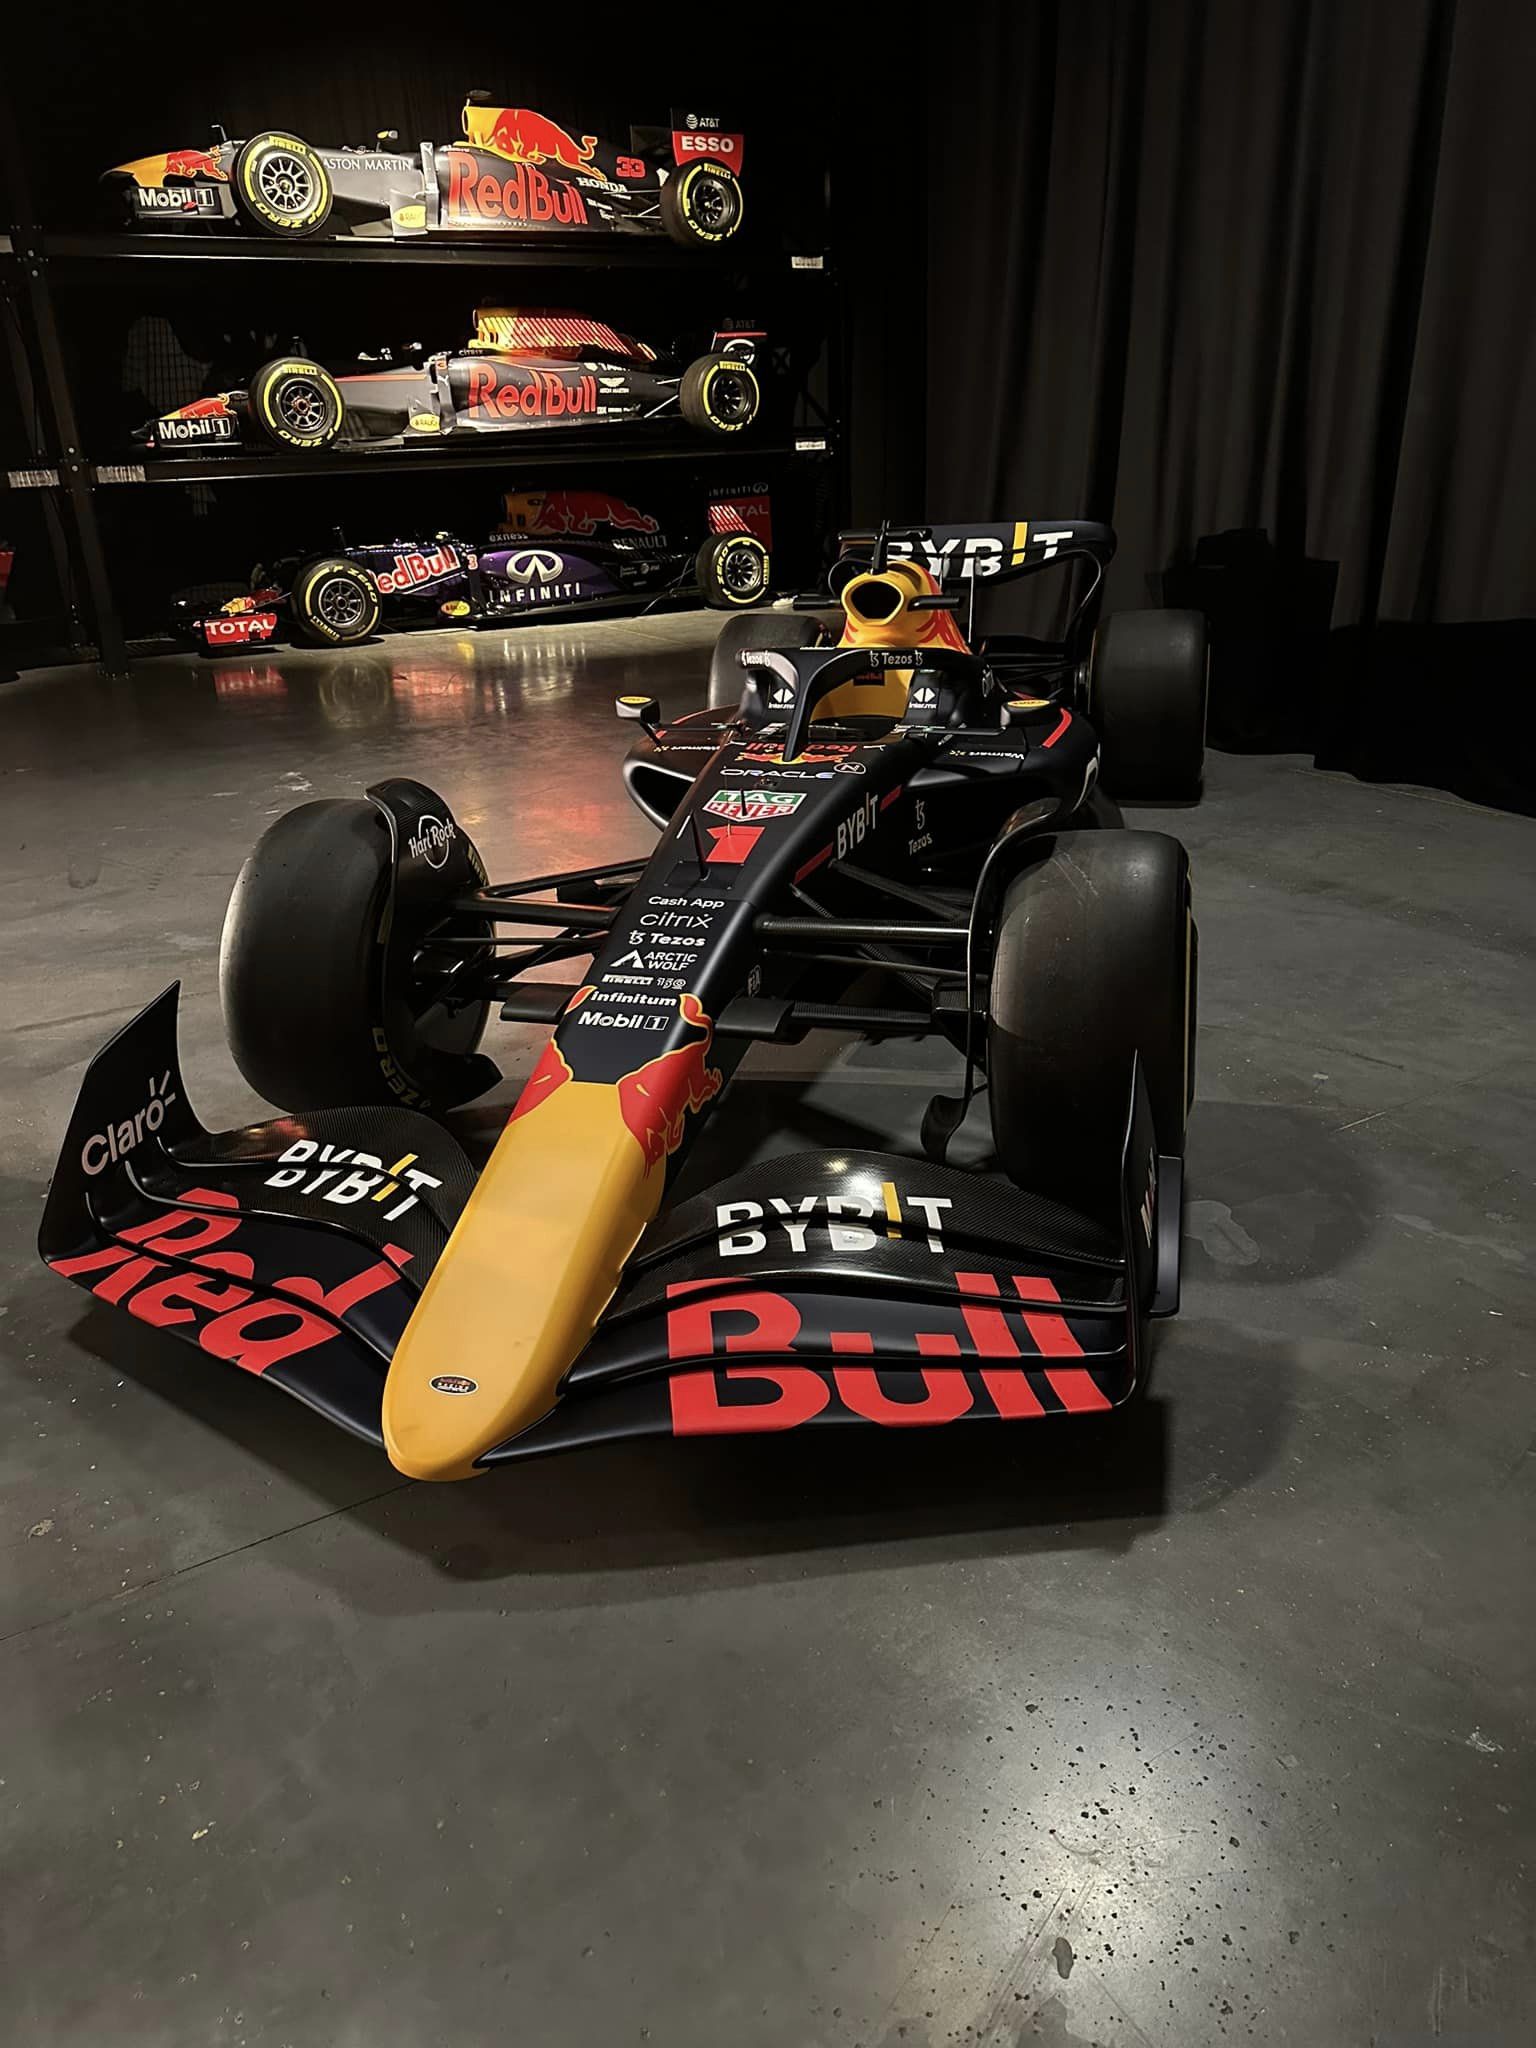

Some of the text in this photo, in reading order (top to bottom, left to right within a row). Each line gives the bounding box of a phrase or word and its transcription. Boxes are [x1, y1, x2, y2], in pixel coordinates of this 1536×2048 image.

[699, 117, 720, 128] AT&T
[681, 135, 735, 153] ESSO
[324, 157, 412, 172] ASTON MARTIN
[616, 156, 646, 178] 33
[576, 176, 629, 193] HONDA
[138, 187, 193, 208] Mobil
[159, 420, 213, 440] Mobil
[488, 582, 582, 603] INFINITI
[206, 617, 276, 637] TOTAL
[881, 651, 913, 665] Tezos
[719, 768, 836, 779] ORACLE
[725, 792, 795, 804] TAG
[709, 804, 794, 818] HEUER
[431, 817, 457, 852] Rock
[837, 792, 879, 861] BYBIT
[706, 825, 766, 864] 1
[908, 831, 934, 857] Tezos
[648, 896, 725, 909] Cash App
[639, 912, 714, 929] citrix
[649, 932, 707, 948] Tezos
[643, 951, 698, 964] ARCTIC
[648, 961, 691, 972] WOLF
[591, 990, 678, 1007] infinitum
[577, 1011, 644, 1029] Mobil
[715, 1181, 953, 1257] BYBIT
[47, 1187, 415, 1377] Red
[665, 1271, 1114, 1437] Bull
